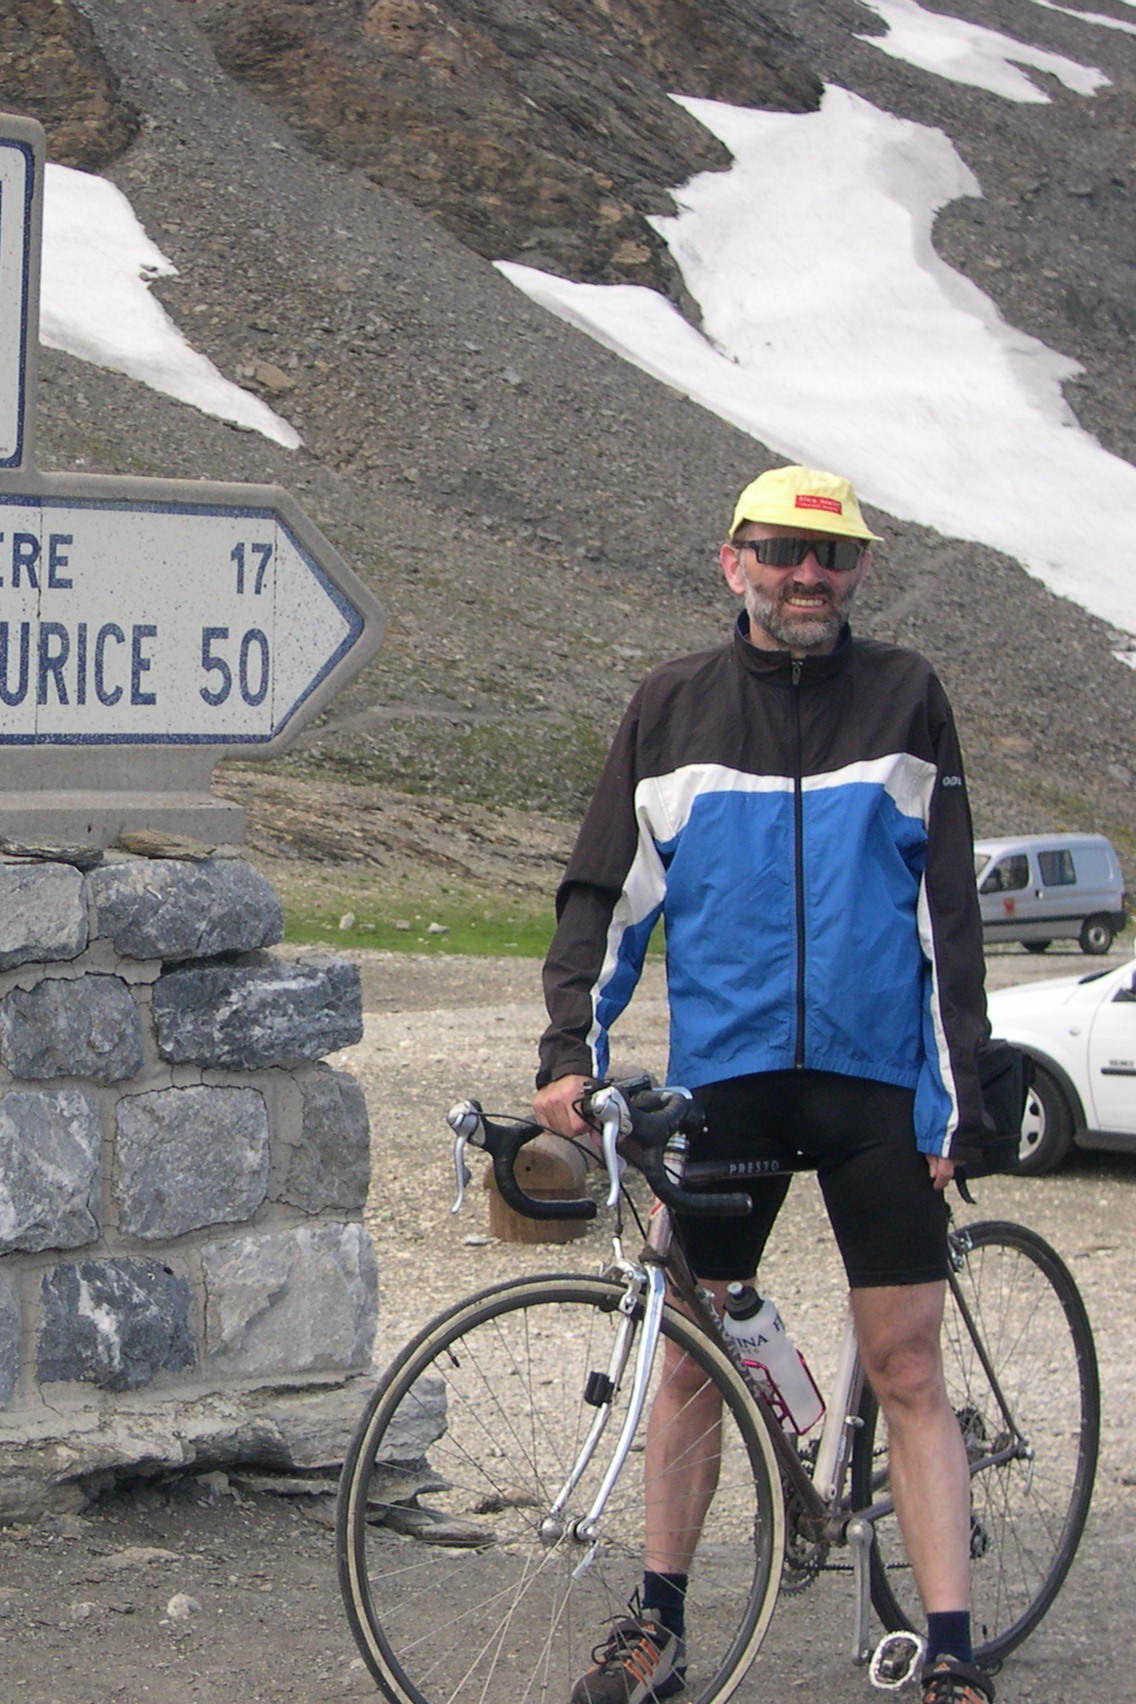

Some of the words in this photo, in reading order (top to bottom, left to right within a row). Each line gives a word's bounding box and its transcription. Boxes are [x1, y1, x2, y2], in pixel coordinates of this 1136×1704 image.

[230, 542, 273, 595] 17
[200, 627, 270, 707] 50
[729, 1160, 780, 1174] PRESTO
